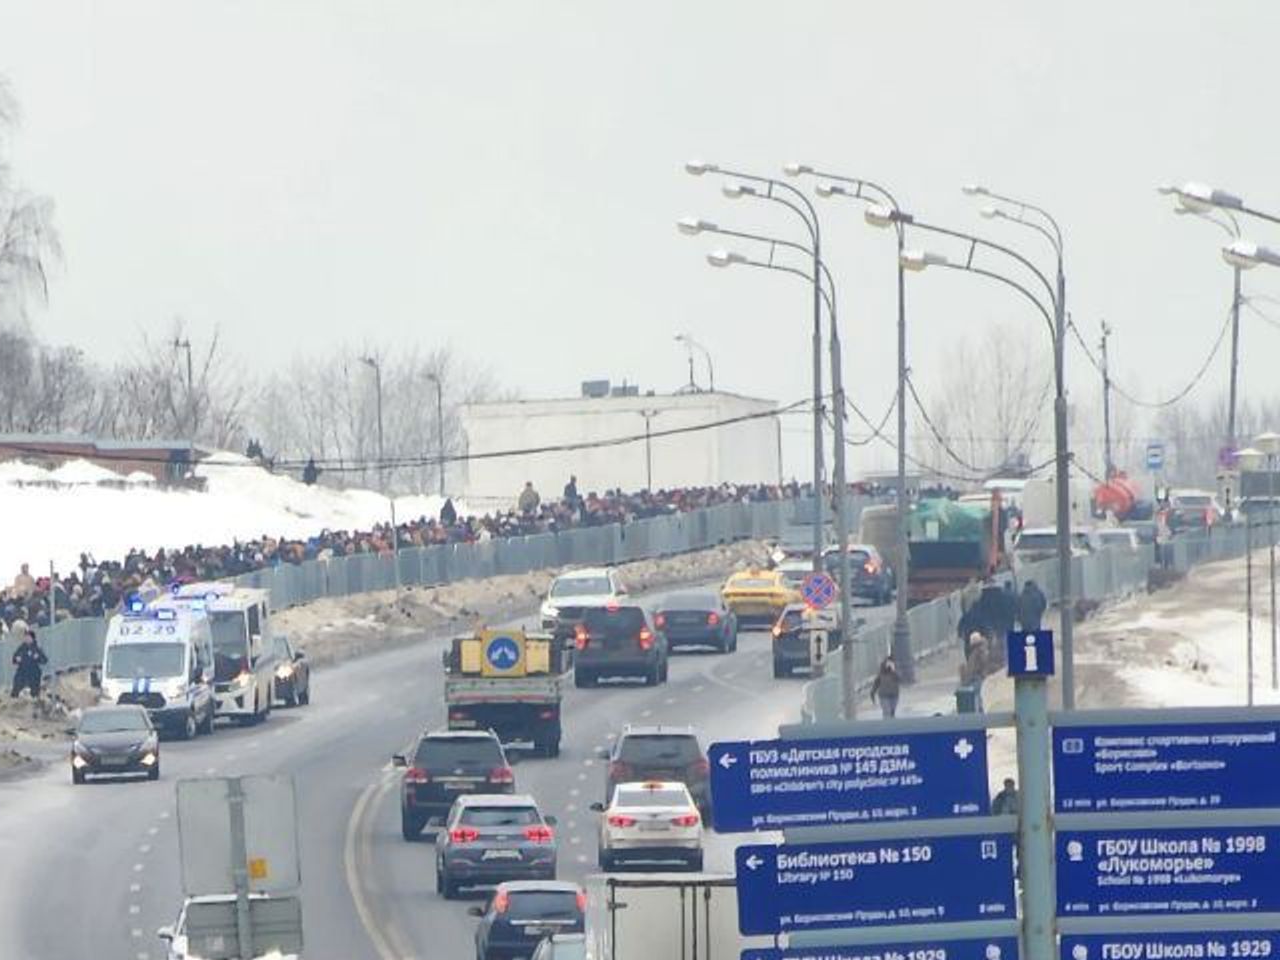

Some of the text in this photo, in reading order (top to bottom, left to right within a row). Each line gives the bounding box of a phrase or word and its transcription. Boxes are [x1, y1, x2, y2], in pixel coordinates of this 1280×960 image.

[749, 749, 778, 764] ГБУЗ
[842, 744, 910, 760] городская
[750, 763, 838, 779] поликлиника
[1097, 836, 1266, 856] ГБОУ Школа № 1998
[776, 846, 932, 870] Библиотека № 150
[1097, 856, 1214, 876] «Лукоморье»
[777, 871, 818, 885] Library
[1101, 940, 1272, 960] ГБОУ Школа № 1929
